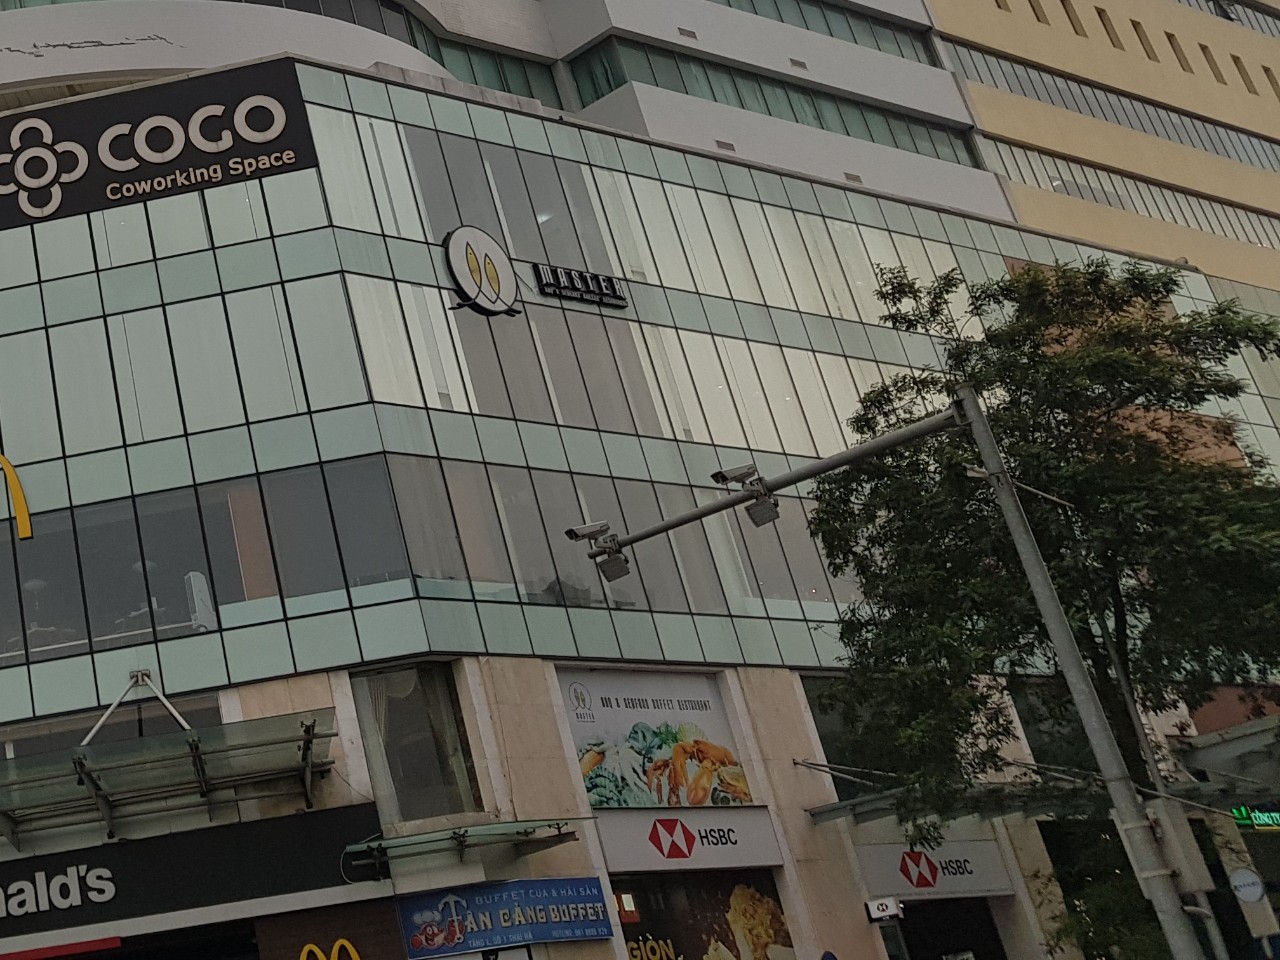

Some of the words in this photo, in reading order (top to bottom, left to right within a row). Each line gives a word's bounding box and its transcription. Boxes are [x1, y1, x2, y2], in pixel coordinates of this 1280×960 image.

[97, 94, 287, 172] COGO
[106, 163, 222, 200] Coworking
[228, 149, 297, 176] Space
[538, 264, 627, 300] MASTER
[697, 827, 738, 846] HSBC
[939, 857, 973, 877] HSBC
[474, 890, 525, 905] BUFFET
[551, 888, 558, 897] &
[550, 902, 606, 921] BUFFET
